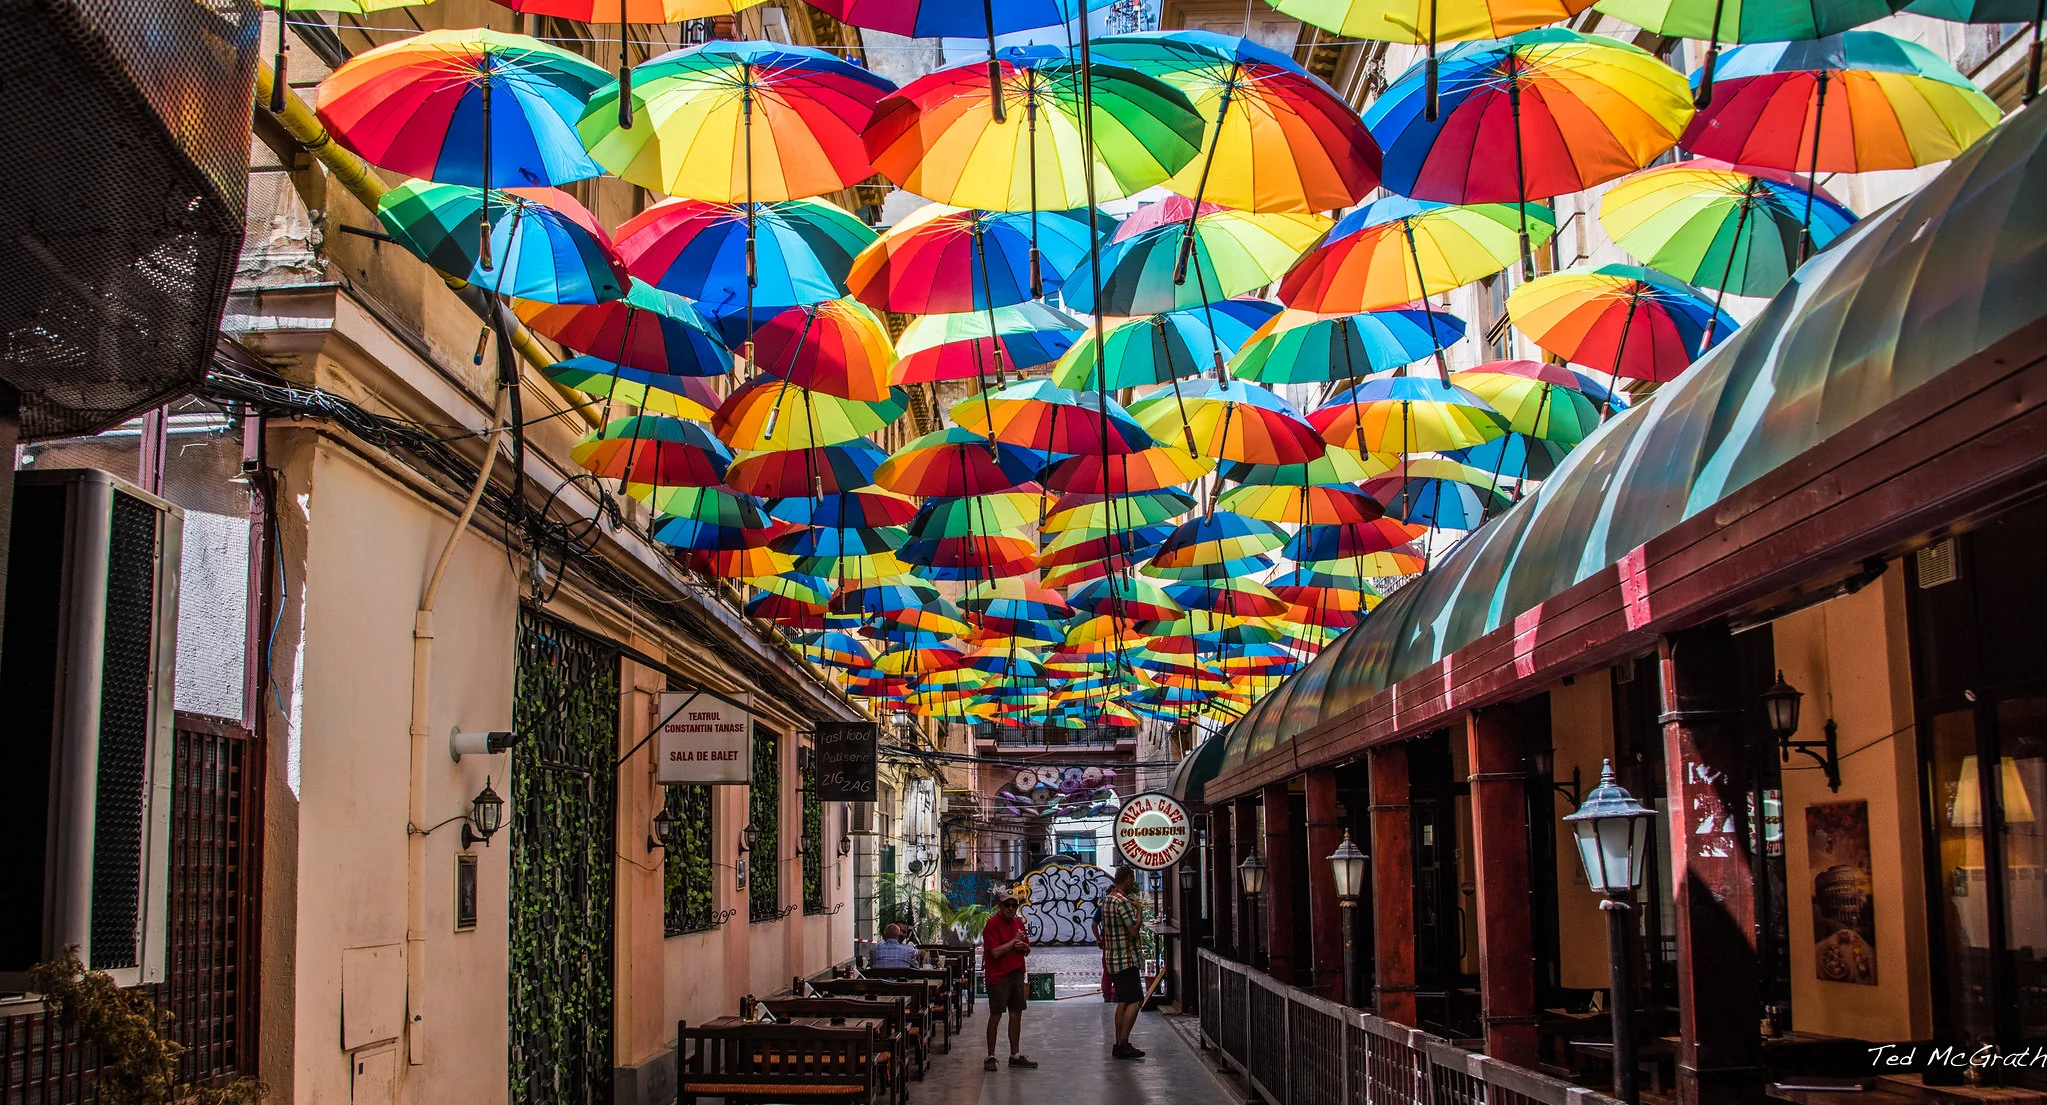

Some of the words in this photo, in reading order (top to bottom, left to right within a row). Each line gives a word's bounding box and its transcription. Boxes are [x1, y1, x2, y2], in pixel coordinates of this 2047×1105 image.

[688, 712, 721, 721] TEATRUL
[664, 724, 713, 733] CONSTANTIN
[714, 723, 744, 733] TANASE
[846, 728, 872, 741] food
[670, 751, 694, 762] SALA
[696, 751, 709, 761] DE
[711, 750, 739, 761] BALET
[821, 771, 844, 786] ZIG
[841, 780, 871, 793] ZAG
[1121, 798, 1153, 825] PIZZA
[1157, 799, 1184, 824] CAFE
[1120, 826, 1186, 837] COLOSSEUM
[1122, 838, 1185, 866] RISTORANTE
